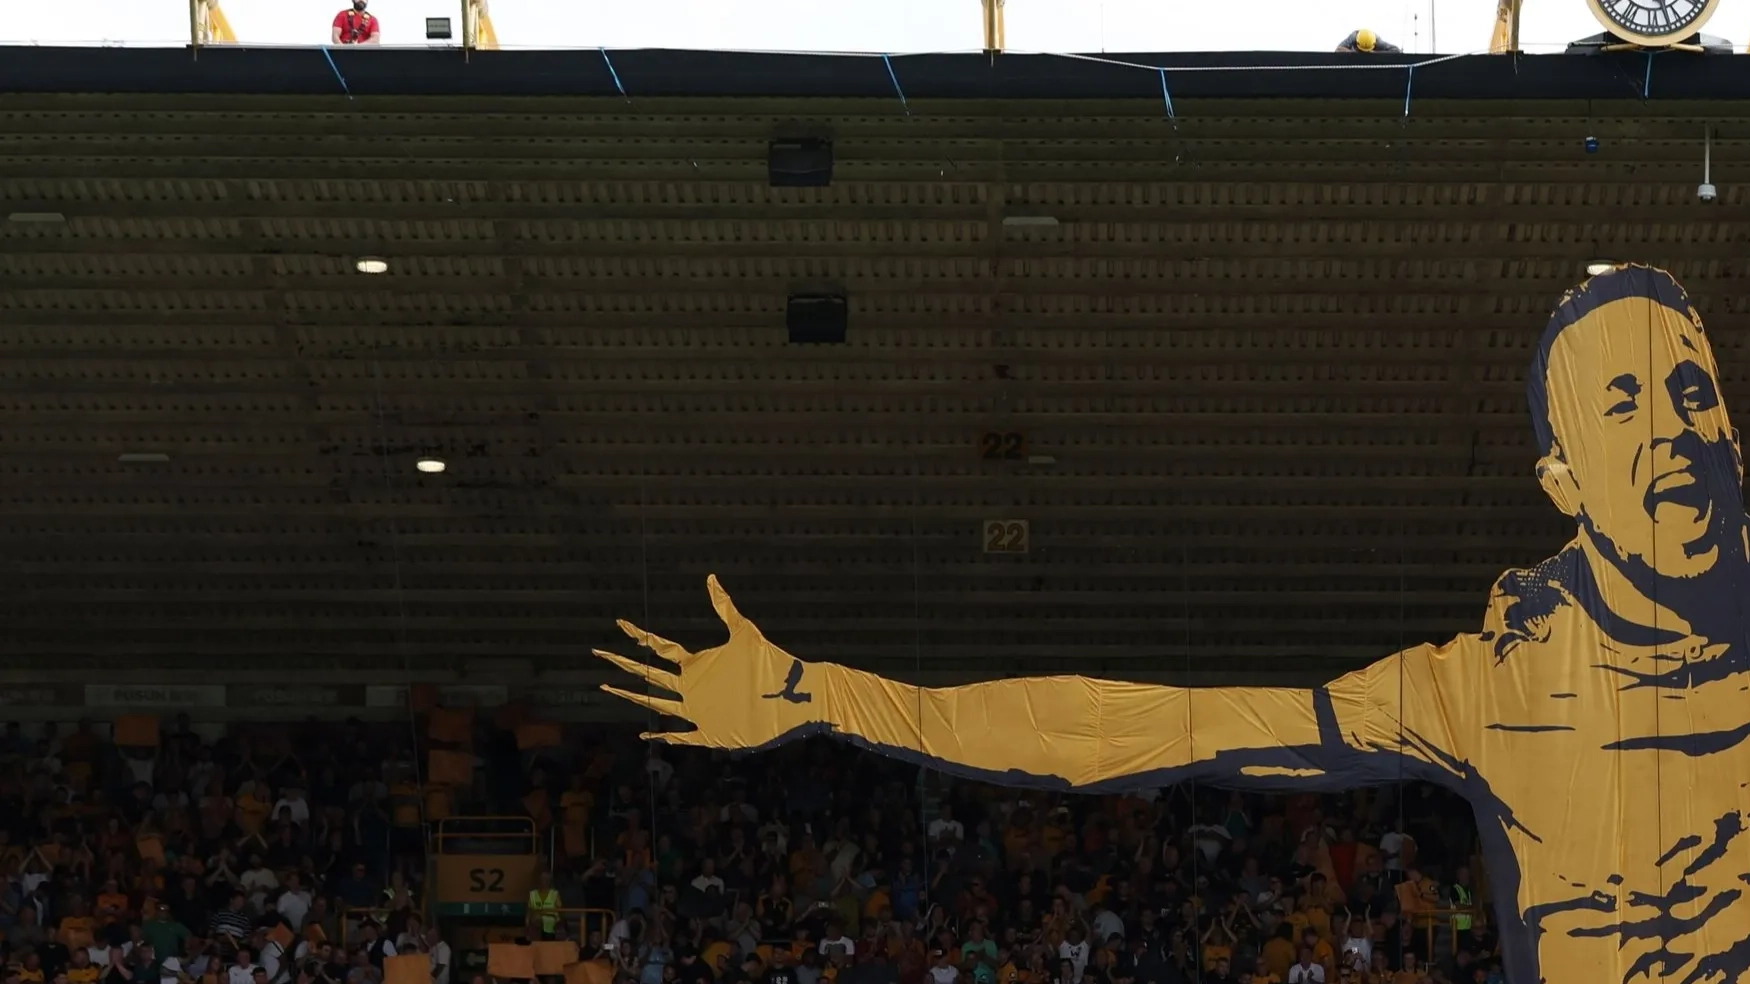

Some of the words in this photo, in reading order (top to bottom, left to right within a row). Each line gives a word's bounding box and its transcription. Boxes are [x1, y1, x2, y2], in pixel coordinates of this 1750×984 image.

[983, 433, 1022, 459] 22
[987, 522, 1025, 551] 22
[469, 867, 505, 892] S2
